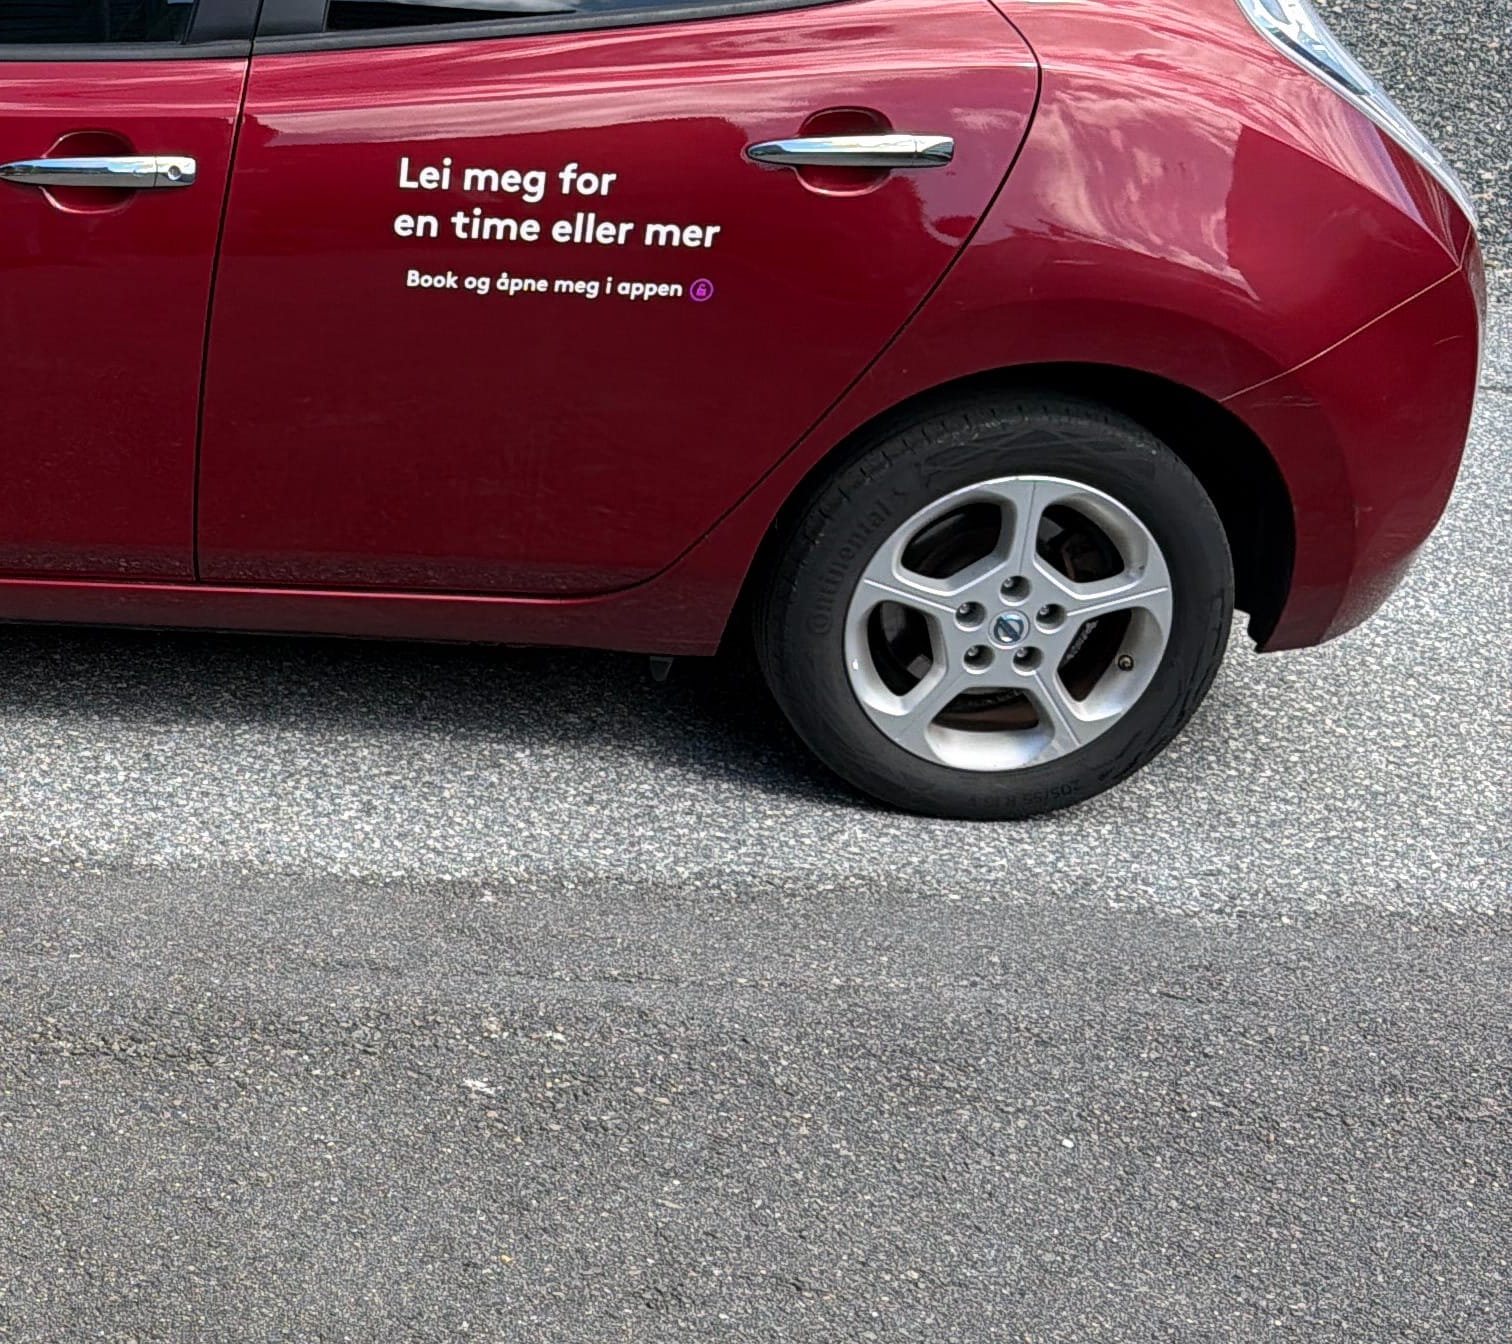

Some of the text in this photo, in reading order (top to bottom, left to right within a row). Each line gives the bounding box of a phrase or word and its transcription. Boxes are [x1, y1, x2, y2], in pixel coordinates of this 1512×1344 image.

[399, 156, 617, 203] Lei meg for
[393, 207, 721, 248] en time eller mer
[406, 269, 683, 301] Book og åpne meg i appen
